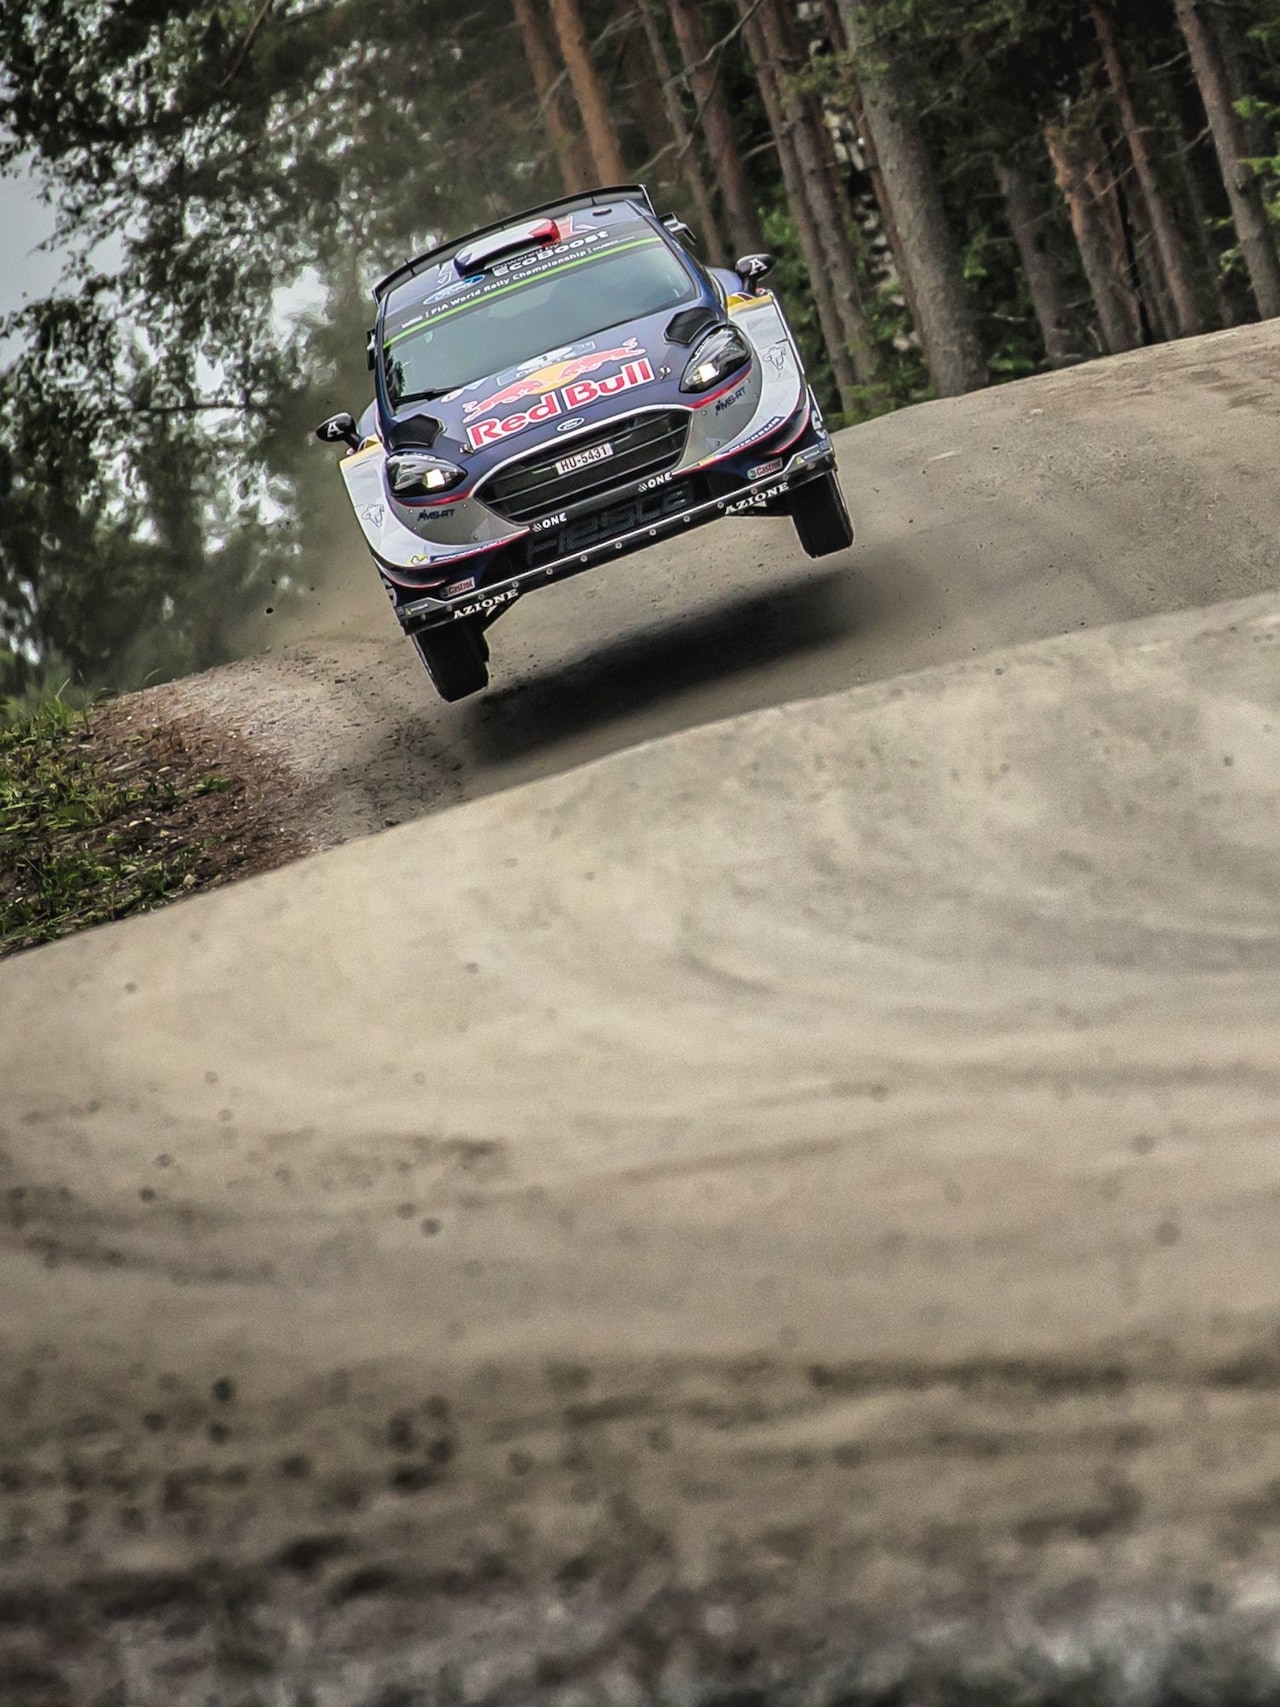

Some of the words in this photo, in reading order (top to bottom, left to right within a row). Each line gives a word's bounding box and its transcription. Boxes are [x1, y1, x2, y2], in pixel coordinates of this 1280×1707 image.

[492, 230, 610, 277] EcoBoost
[749, 257, 768, 276] A
[431, 303, 449, 315] FIA
[450, 290, 481, 306] World
[483, 278, 510, 292] Rally
[512, 250, 587, 281] Championship
[467, 393, 560, 448] Red
[563, 360, 653, 408] Bull
[327, 421, 344, 438] A
[560, 446, 609, 472] HU-5431
[756, 460, 782, 475] Castrol
[648, 472, 673, 489] ONE
[725, 482, 790, 515] AZIONE
[542, 512, 567, 529] ONE
[448, 578, 474, 595] Castrol
[453, 588, 519, 619] AZIONE
